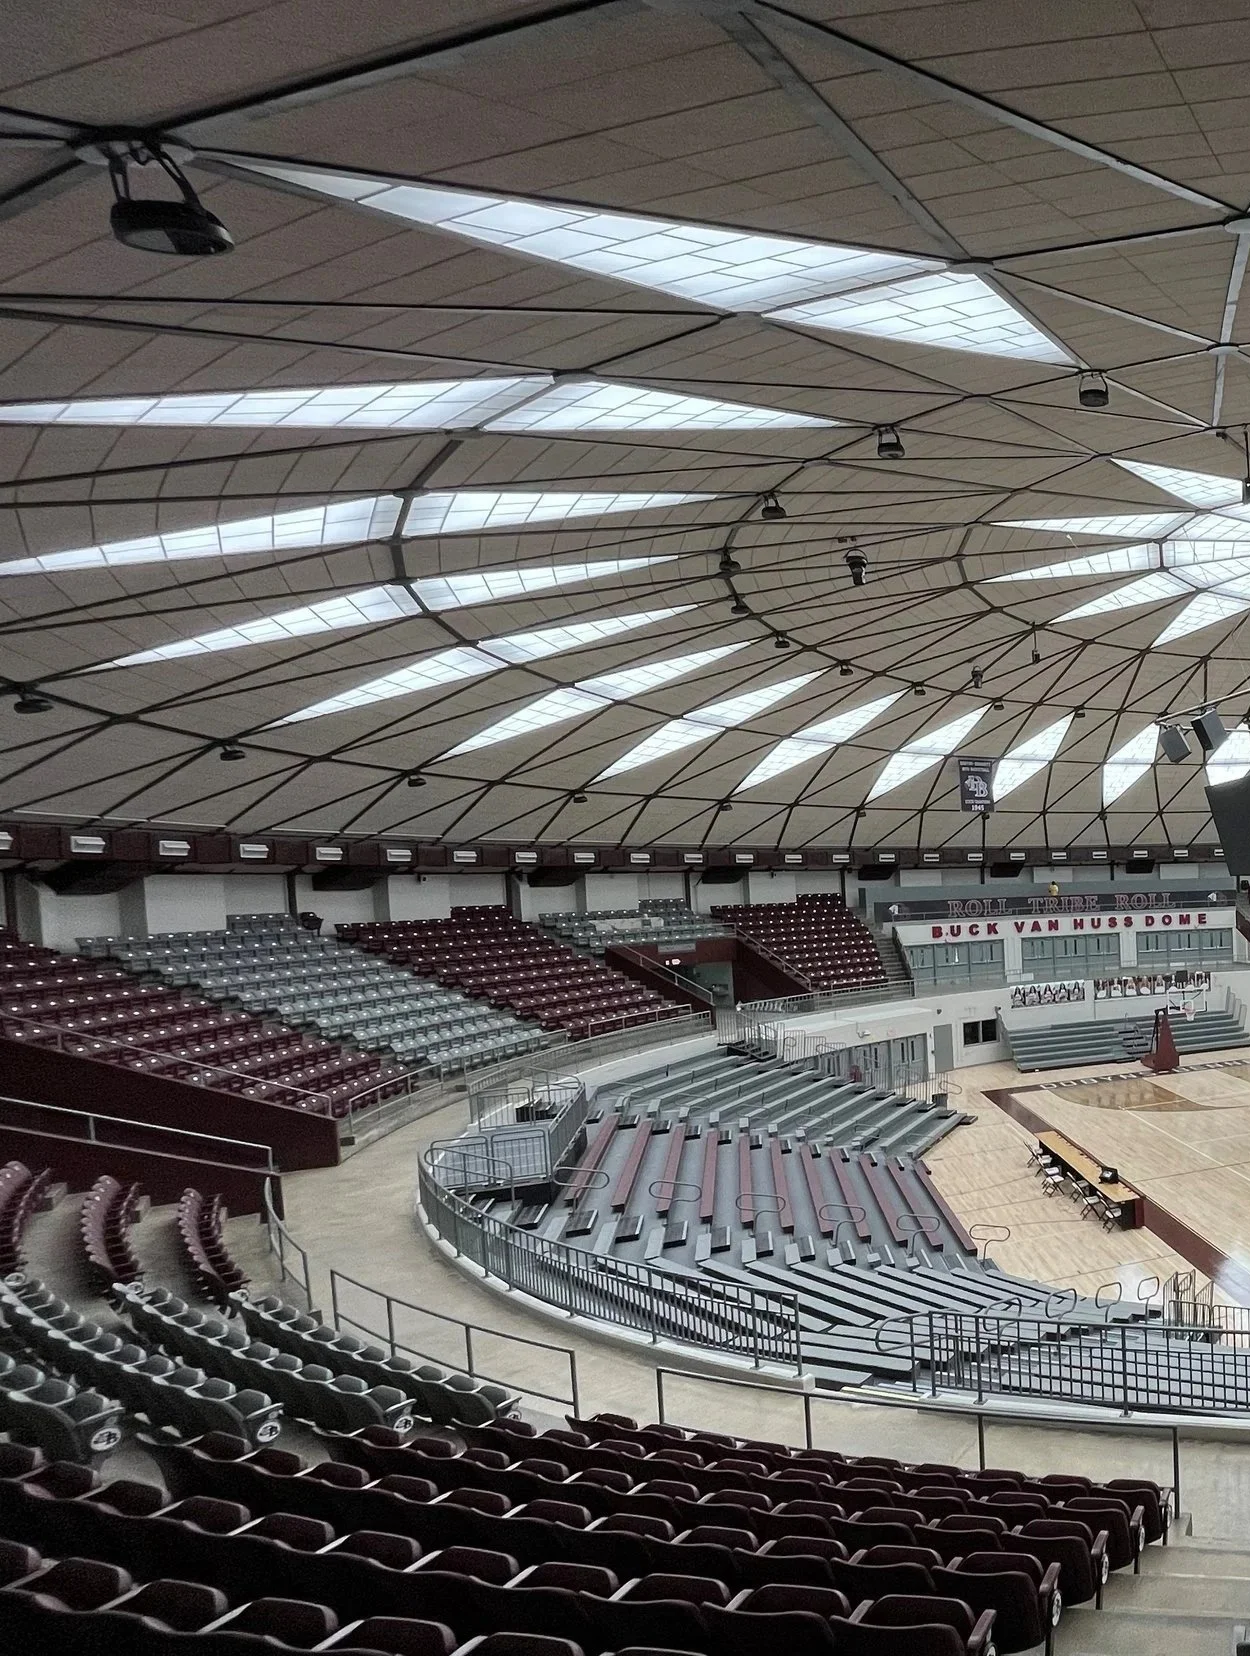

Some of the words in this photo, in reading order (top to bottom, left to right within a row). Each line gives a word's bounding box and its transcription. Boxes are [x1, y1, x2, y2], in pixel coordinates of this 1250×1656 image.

[948, 898, 1012, 918] ROLL
[1028, 895, 1100, 915] TRIBE
[1114, 892, 1176, 911] ROLL
[931, 922, 999, 939] BUCK
[1014, 919, 1059, 934] VAN
[1073, 915, 1134, 930] HUSS
[1145, 913, 1207, 927] DOME
